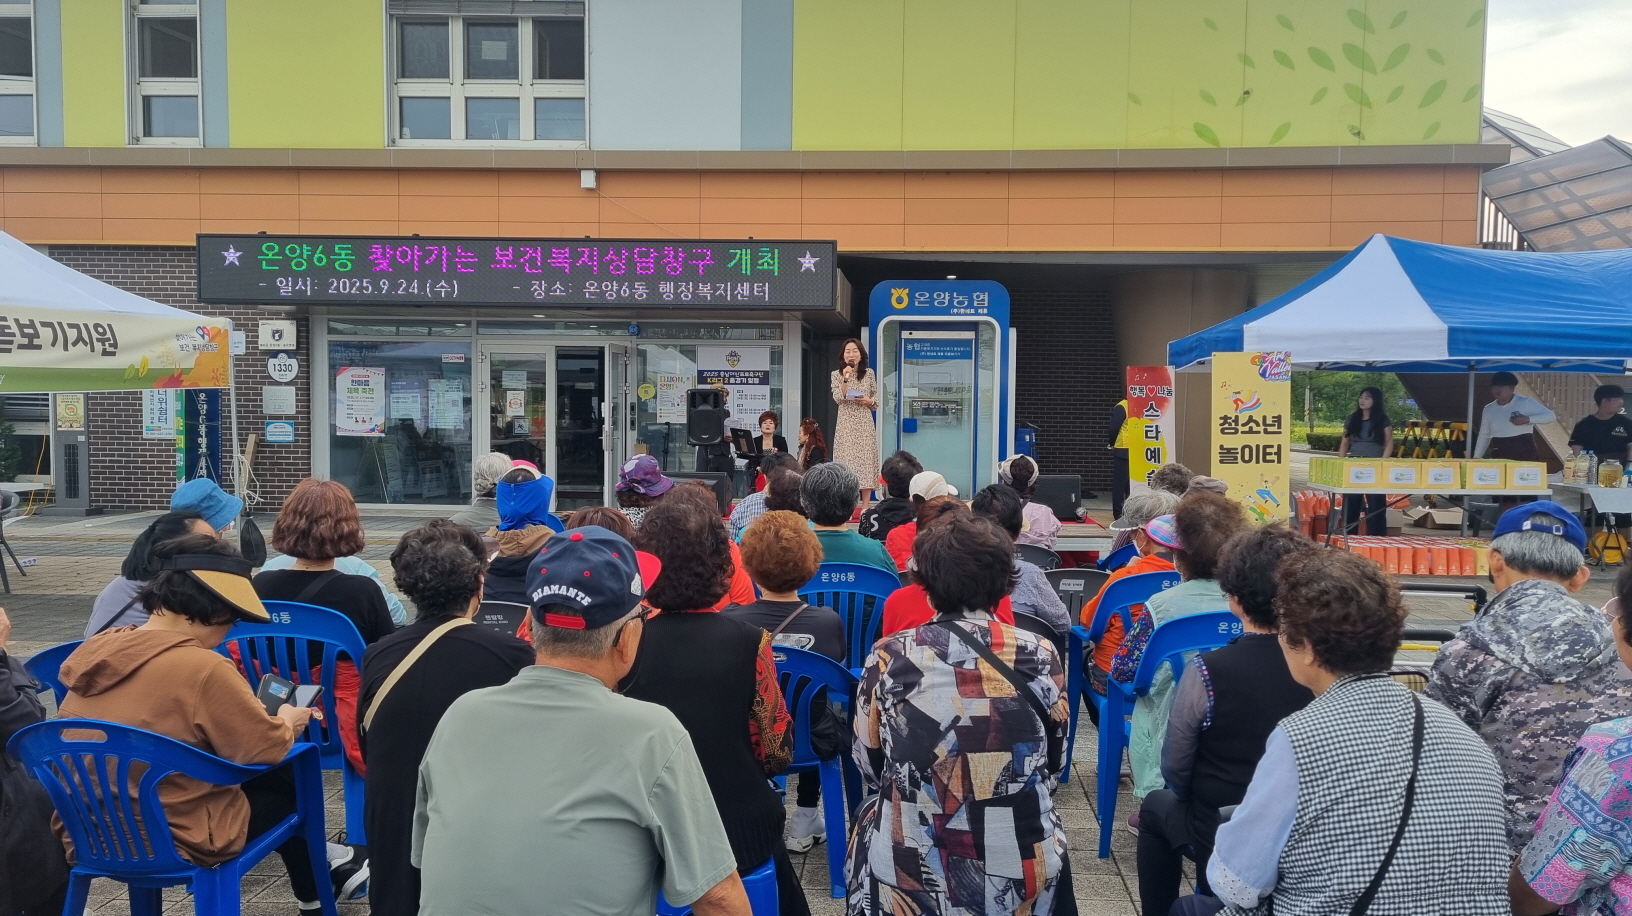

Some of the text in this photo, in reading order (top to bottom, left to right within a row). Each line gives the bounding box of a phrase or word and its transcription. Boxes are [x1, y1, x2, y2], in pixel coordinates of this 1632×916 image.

[257, 242, 780, 276] 온양6동 찾아가는 보건복지상담창구 개최
[276, 276, 319, 296] 일시:
[328, 278, 459, 298] 2025.9.24.(수)
[530, 281, 574, 300] 장소:
[583, 281, 650, 300] 온양6동
[658, 281, 771, 302] 행정복지센터
[913, 291, 989, 307] 온양농협
[272, 363, 293, 373] 1330
[1128, 385, 1174, 397] 행복 나눔
[1218, 414, 1283, 436] 청소년
[1218, 443, 1283, 465] 놀이터
[820, 571, 856, 583] 온양6동
[532, 584, 592, 606] DIAMANTE
